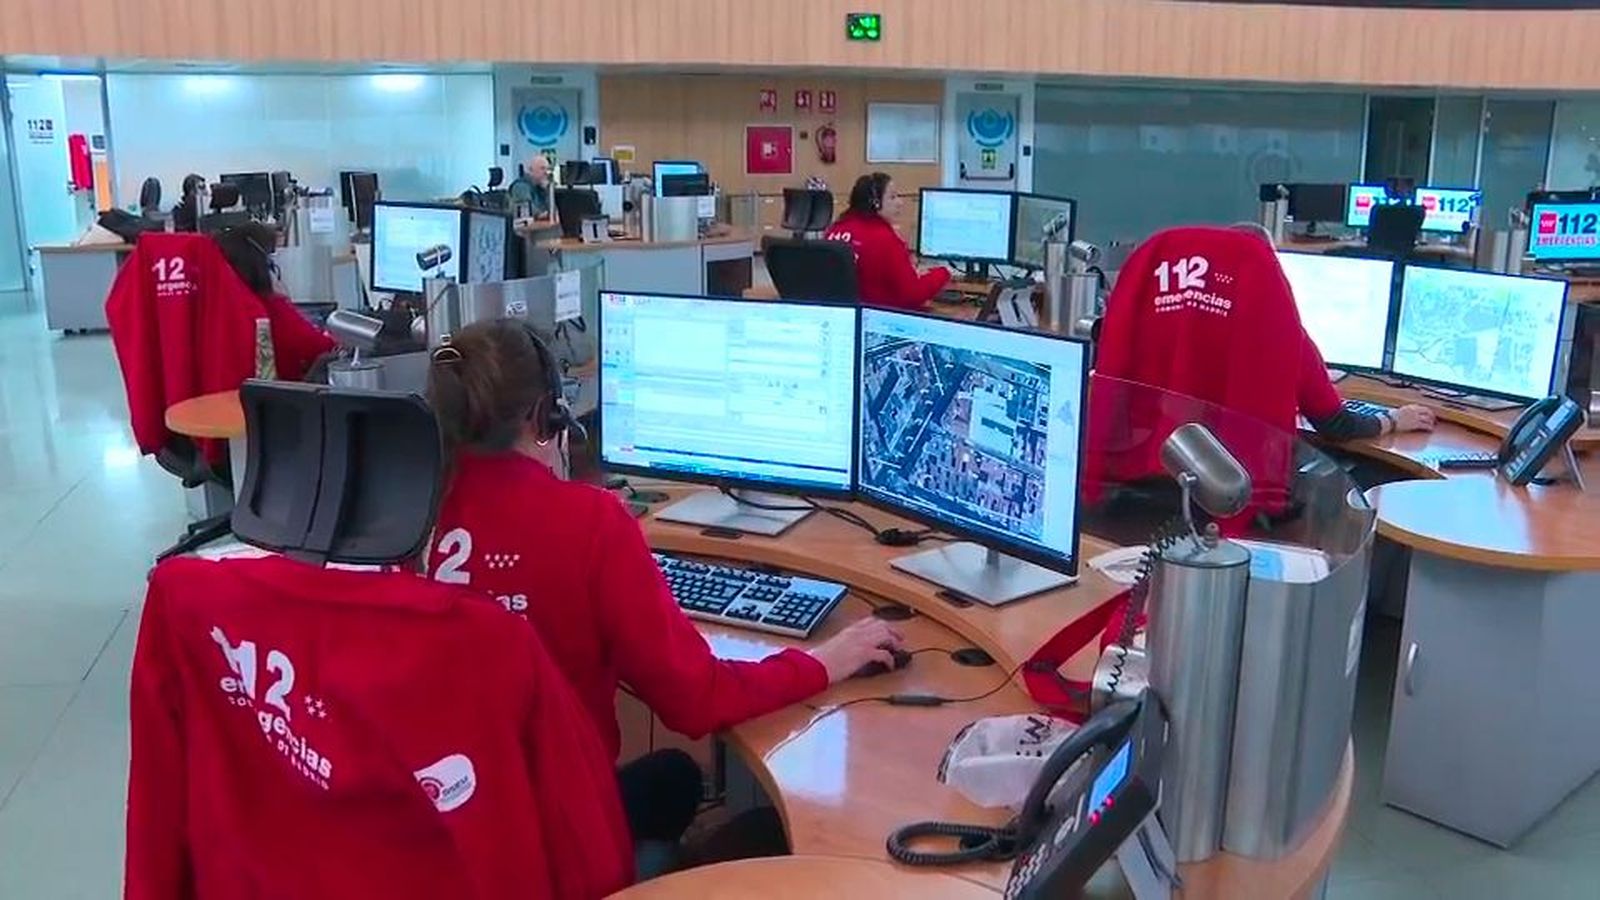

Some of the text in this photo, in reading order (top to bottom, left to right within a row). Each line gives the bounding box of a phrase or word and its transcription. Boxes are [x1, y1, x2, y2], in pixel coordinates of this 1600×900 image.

[1439, 197, 1470, 213] 112
[1558, 213, 1598, 235] 112
[151, 256, 186, 281] 12
[1153, 255, 1209, 293] 112
